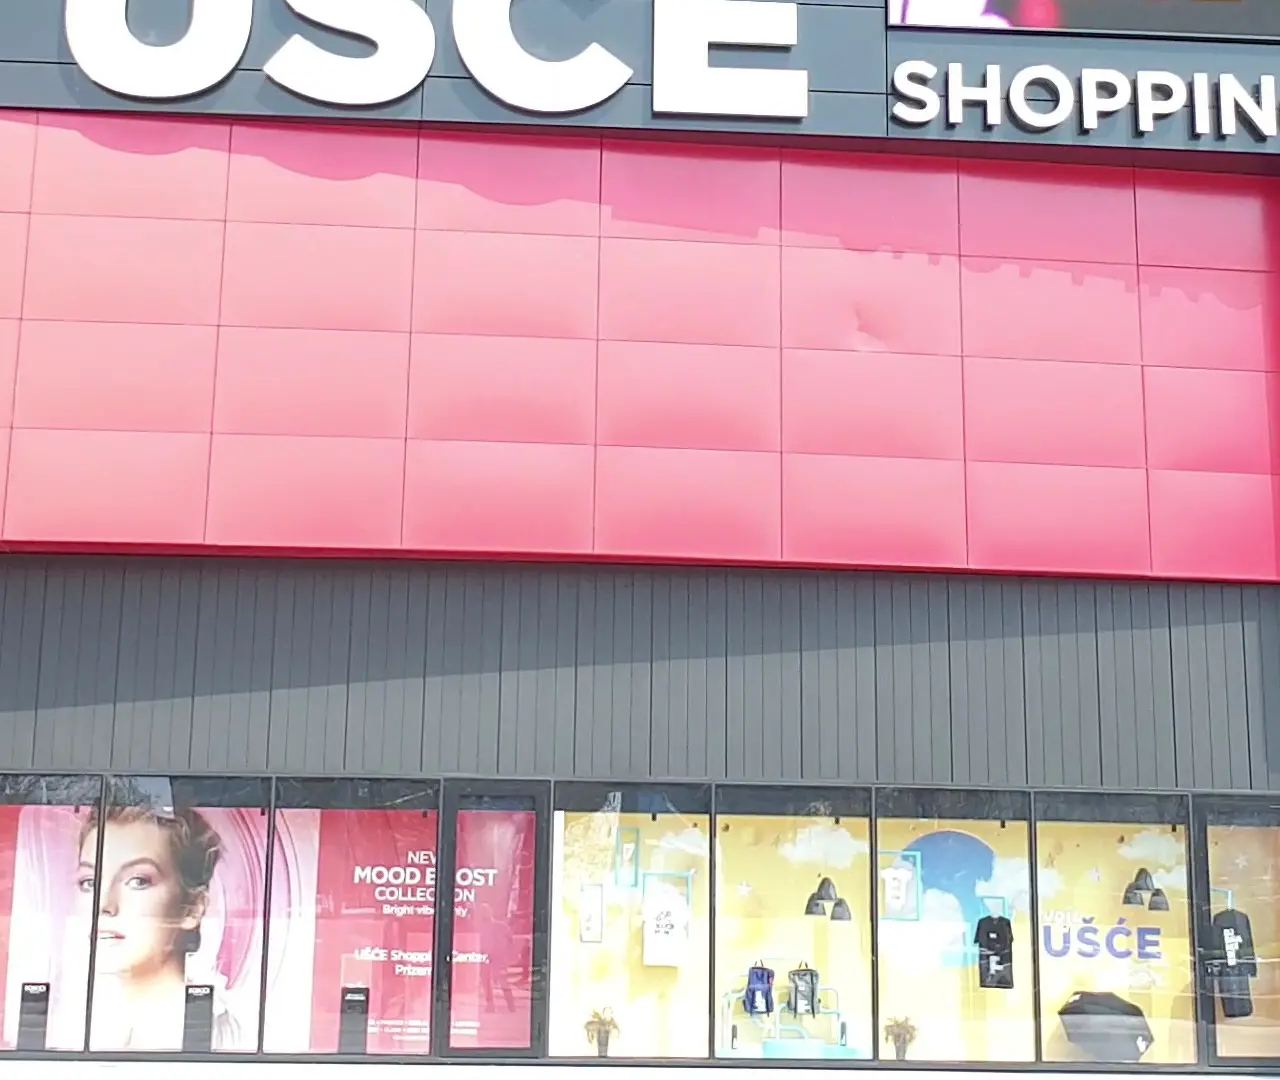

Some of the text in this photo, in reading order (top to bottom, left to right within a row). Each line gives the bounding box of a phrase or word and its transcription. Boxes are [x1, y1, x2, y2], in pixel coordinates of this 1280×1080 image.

[353, 866, 498, 887] MOOD BOST
[374, 887, 476, 902] COLLECON
[382, 903, 415, 916] Bright
[1042, 916, 1162, 959] UŠĆE
